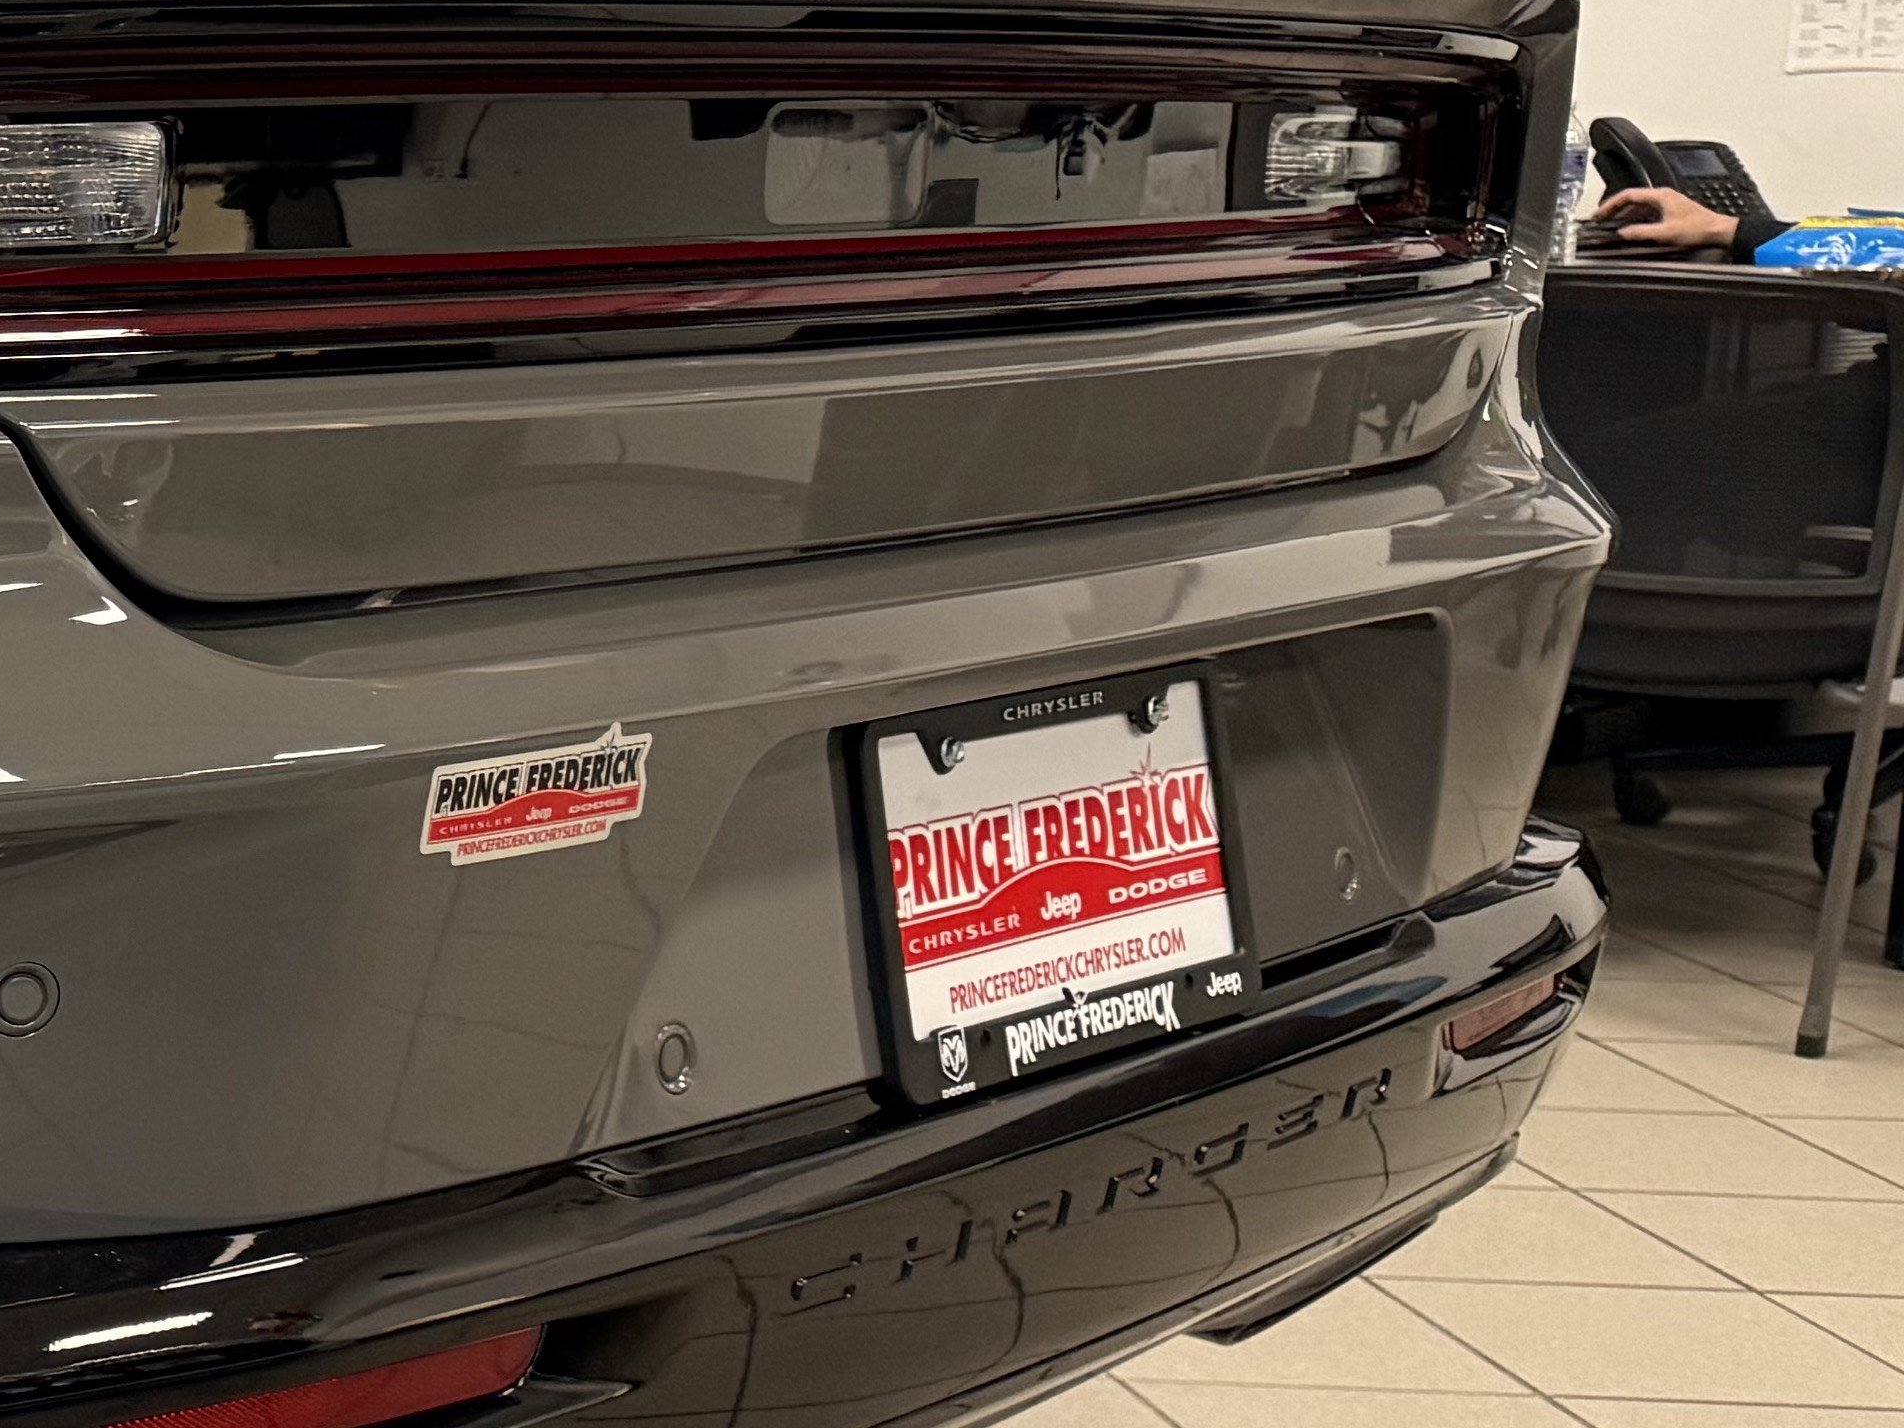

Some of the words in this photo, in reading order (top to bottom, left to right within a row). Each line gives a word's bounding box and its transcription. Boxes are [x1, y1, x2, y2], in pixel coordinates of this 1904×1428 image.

[1002, 691, 1104, 722] CHRYSLER
[434, 766, 521, 815] PRINCE
[525, 745, 642, 793] FREDERICK
[438, 815, 513, 836] CHRYSLER
[525, 805, 553, 823] Jeep
[568, 796, 630, 815] DODGE
[888, 810, 1016, 907] PRINCE
[1023, 772, 1218, 866] FREDERICK
[908, 913, 1022, 955] CHRYSLER
[1040, 890, 1083, 923] Jeep
[1107, 867, 1209, 905] DODGE
[949, 926, 1187, 1014] PRINCEFREDERICKCHRYSLER.COM
[1206, 970, 1243, 998] Jeep
[1004, 1006, 1077, 1078] PRINCE
[1077, 980, 1182, 1039] FREDERICK
[790, 1068, 1393, 1307] CHARGER
